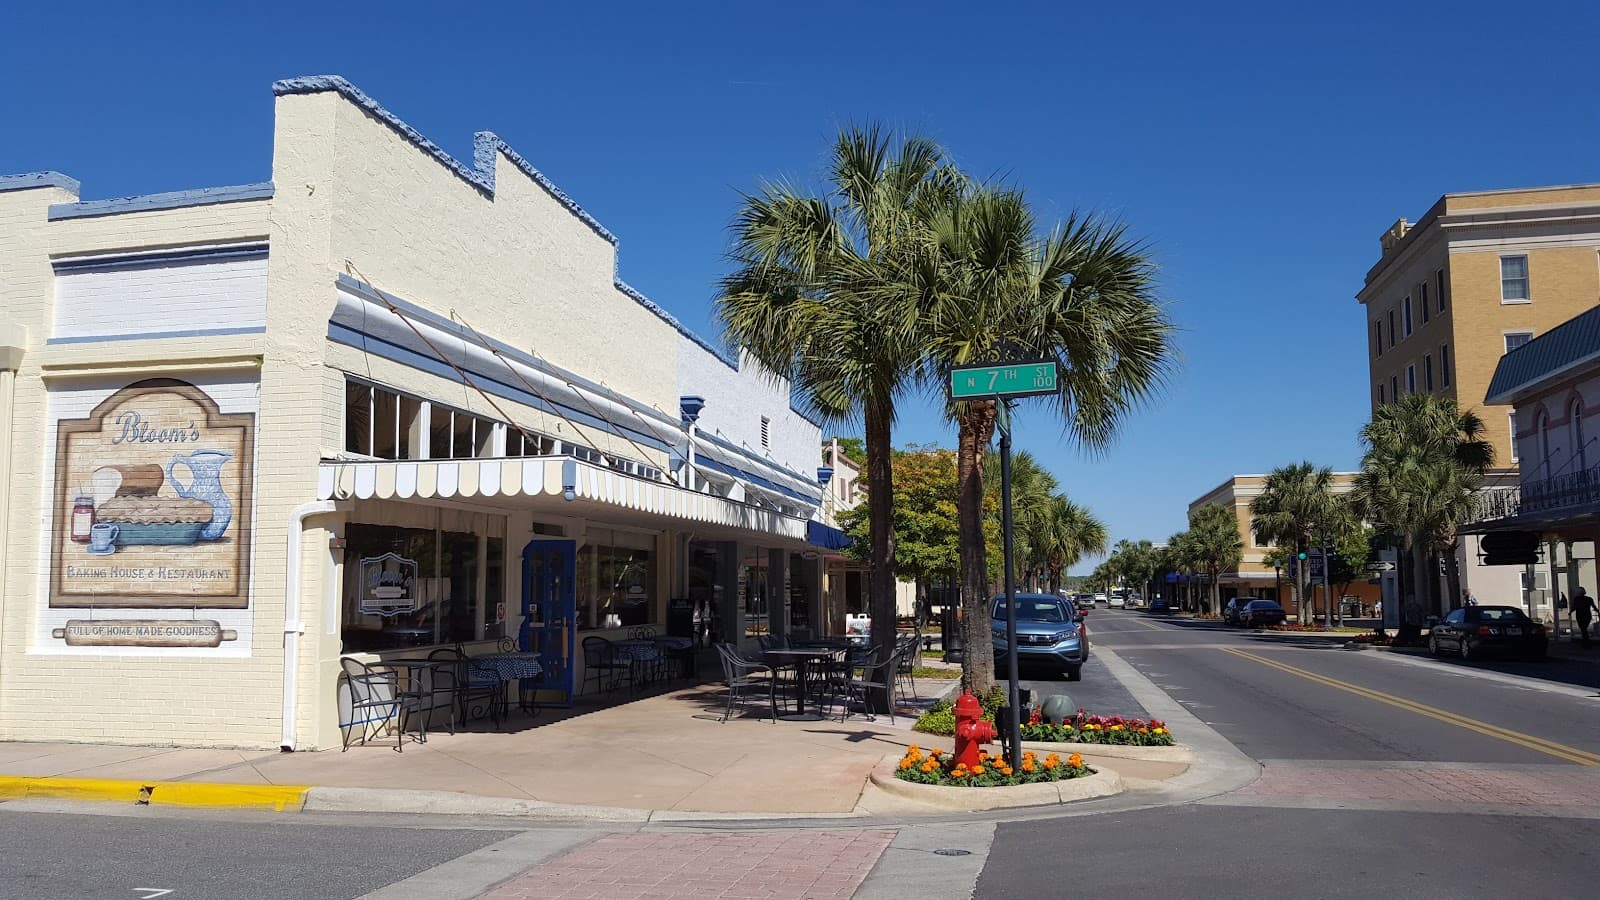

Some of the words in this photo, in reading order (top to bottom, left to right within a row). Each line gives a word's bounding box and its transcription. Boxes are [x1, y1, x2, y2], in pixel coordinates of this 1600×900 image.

[967, 377, 975, 388] N
[1036, 366, 1049, 377] ST
[1033, 376, 1053, 388] 100
[112, 410, 200, 445] Bloom's
[67, 565, 107, 578] BAKING
[110, 565, 145, 579] HOUSE
[158, 566, 231, 579] RESTAURANT
[68, 626, 90, 636] FULL
[92, 626, 104, 636] OF
[135, 626, 163, 636] MADE
[165, 626, 217, 637] GOODNESS
